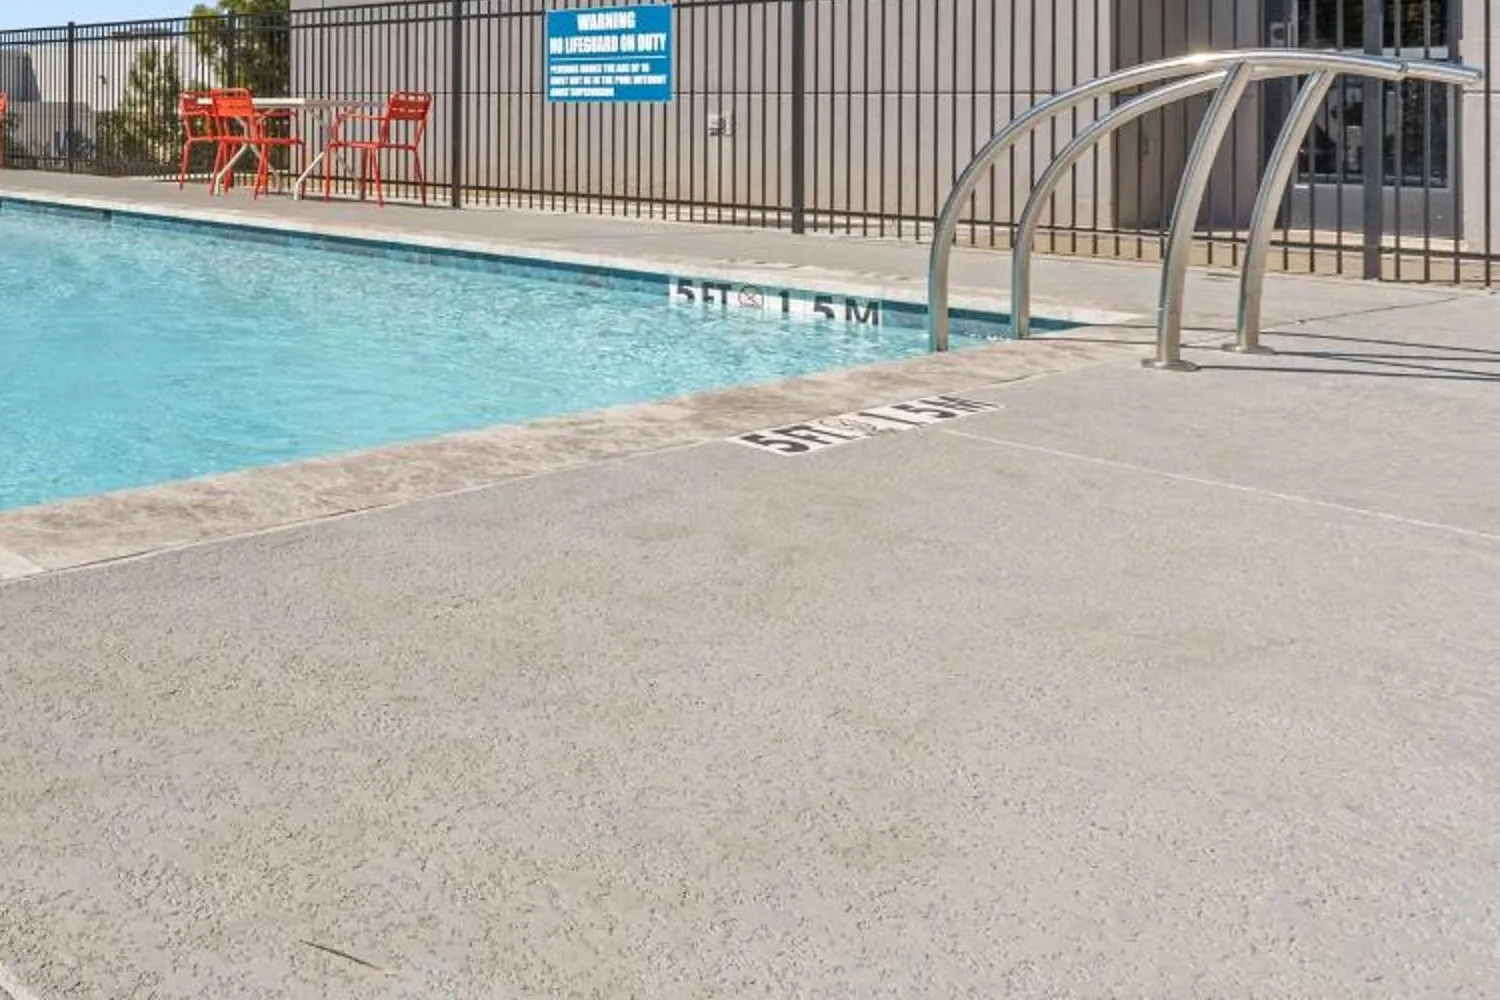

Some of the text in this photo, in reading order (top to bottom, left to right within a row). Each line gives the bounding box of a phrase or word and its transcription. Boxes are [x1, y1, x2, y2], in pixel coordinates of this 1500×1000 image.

[577, 11, 636, 31] WARNING
[550, 32, 667, 55] NO LIFEGUARD ON DUTY
